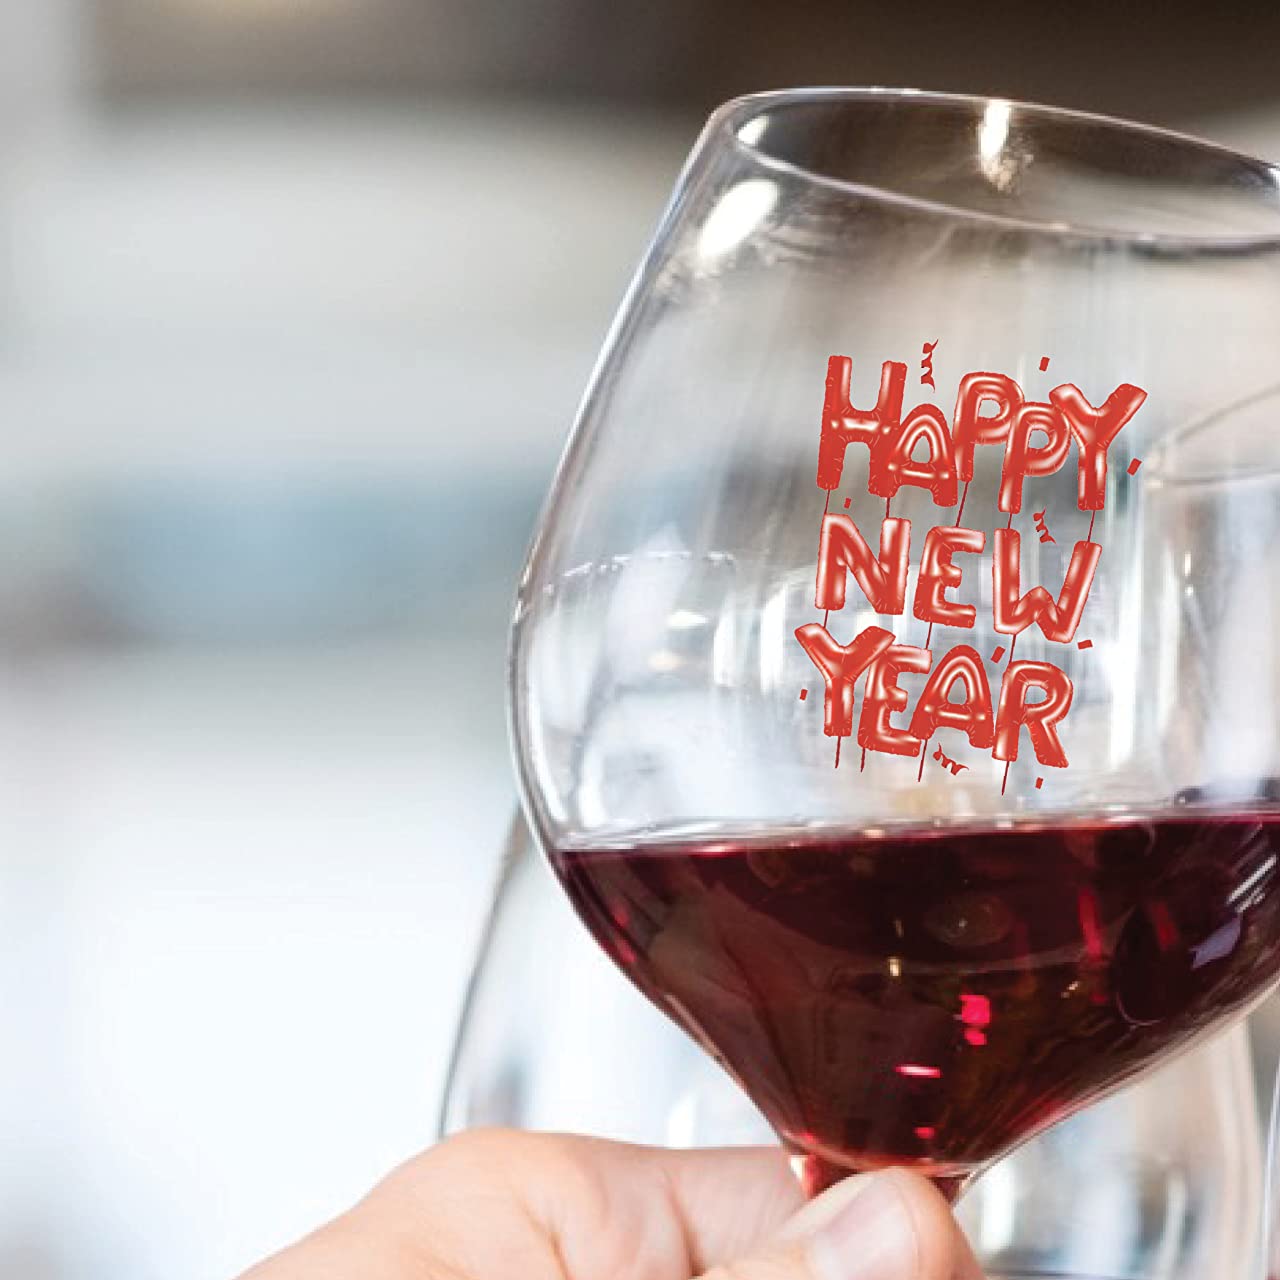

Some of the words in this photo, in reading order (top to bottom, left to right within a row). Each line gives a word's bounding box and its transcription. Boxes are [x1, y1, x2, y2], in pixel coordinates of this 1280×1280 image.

[816, 356, 1147, 515] HAPPY
[815, 513, 1102, 643] NEW
[794, 623, 1074, 768] YEAR
